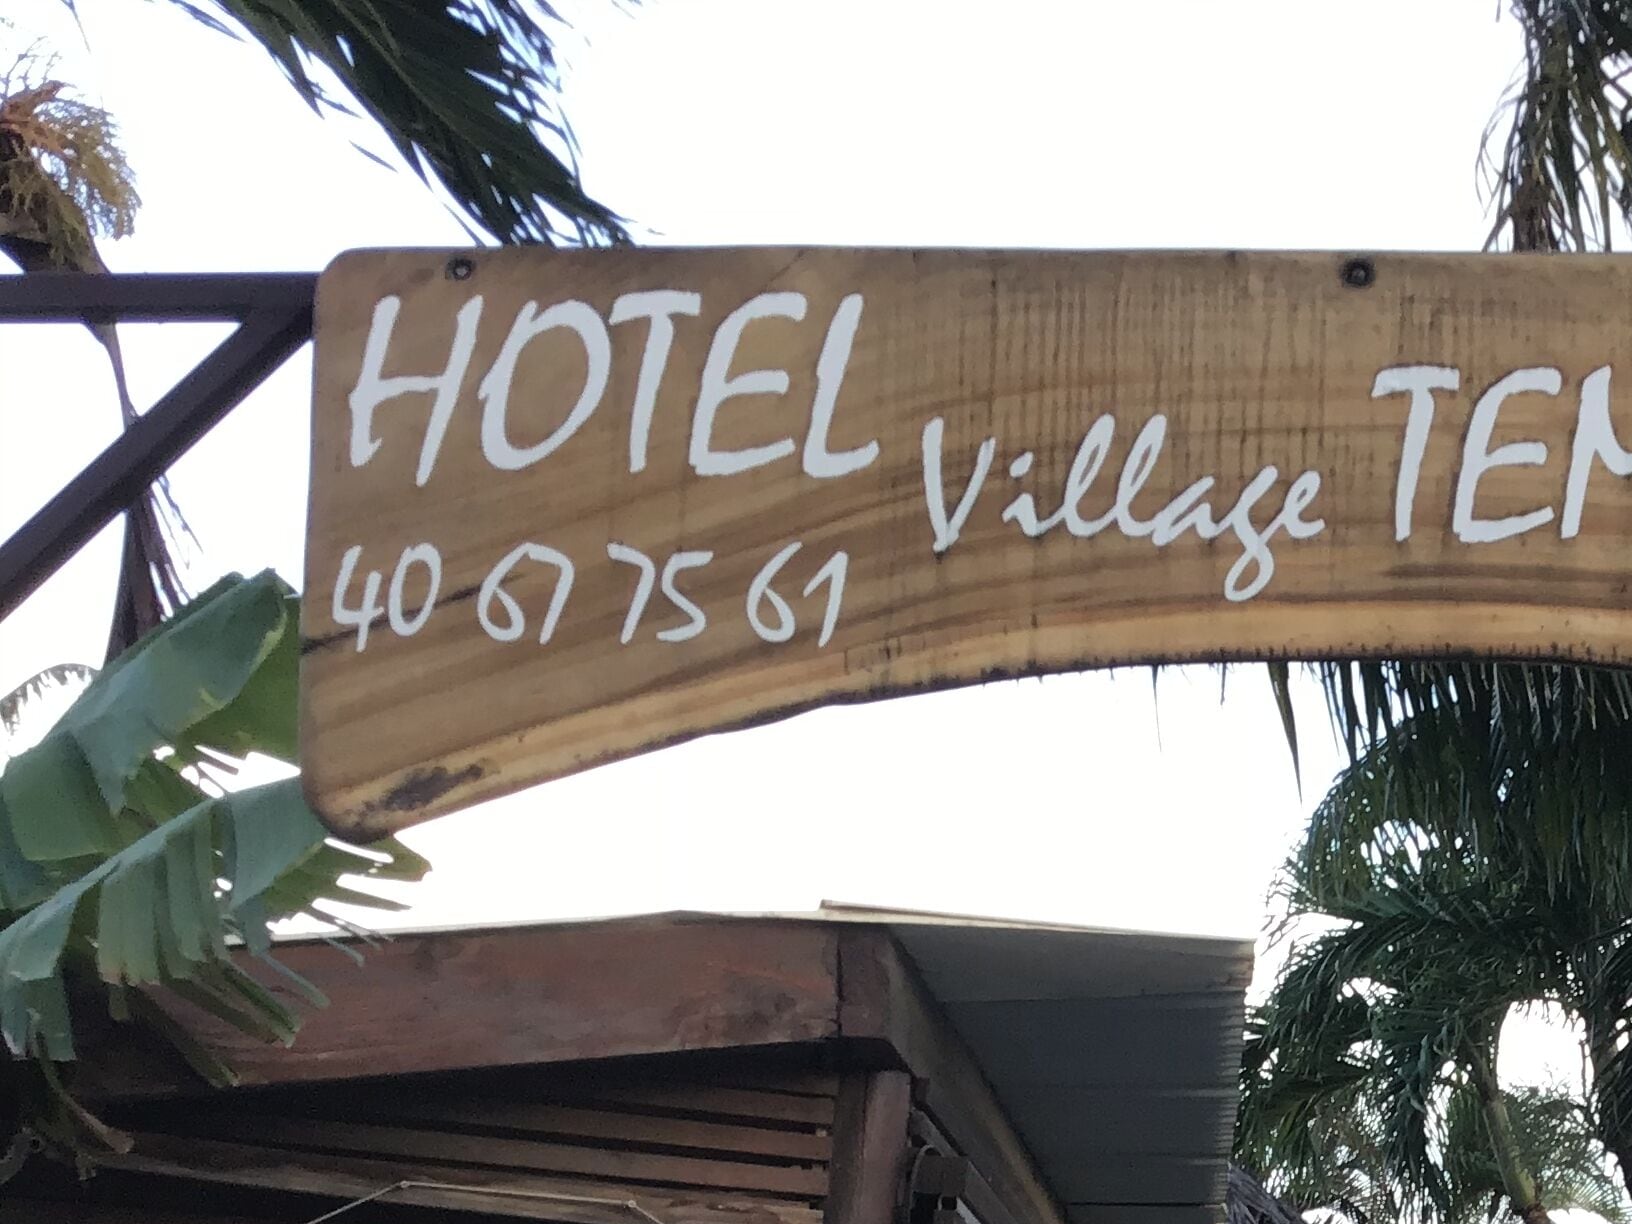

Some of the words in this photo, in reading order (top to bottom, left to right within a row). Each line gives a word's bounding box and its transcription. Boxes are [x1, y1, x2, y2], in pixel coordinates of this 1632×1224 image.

[349, 290, 879, 487] HOTEL
[921, 413, 1325, 601] Village
[333, 543, 441, 652] 40
[477, 542, 575, 645] 67
[607, 540, 714, 644] 75
[746, 541, 848, 647] 61
